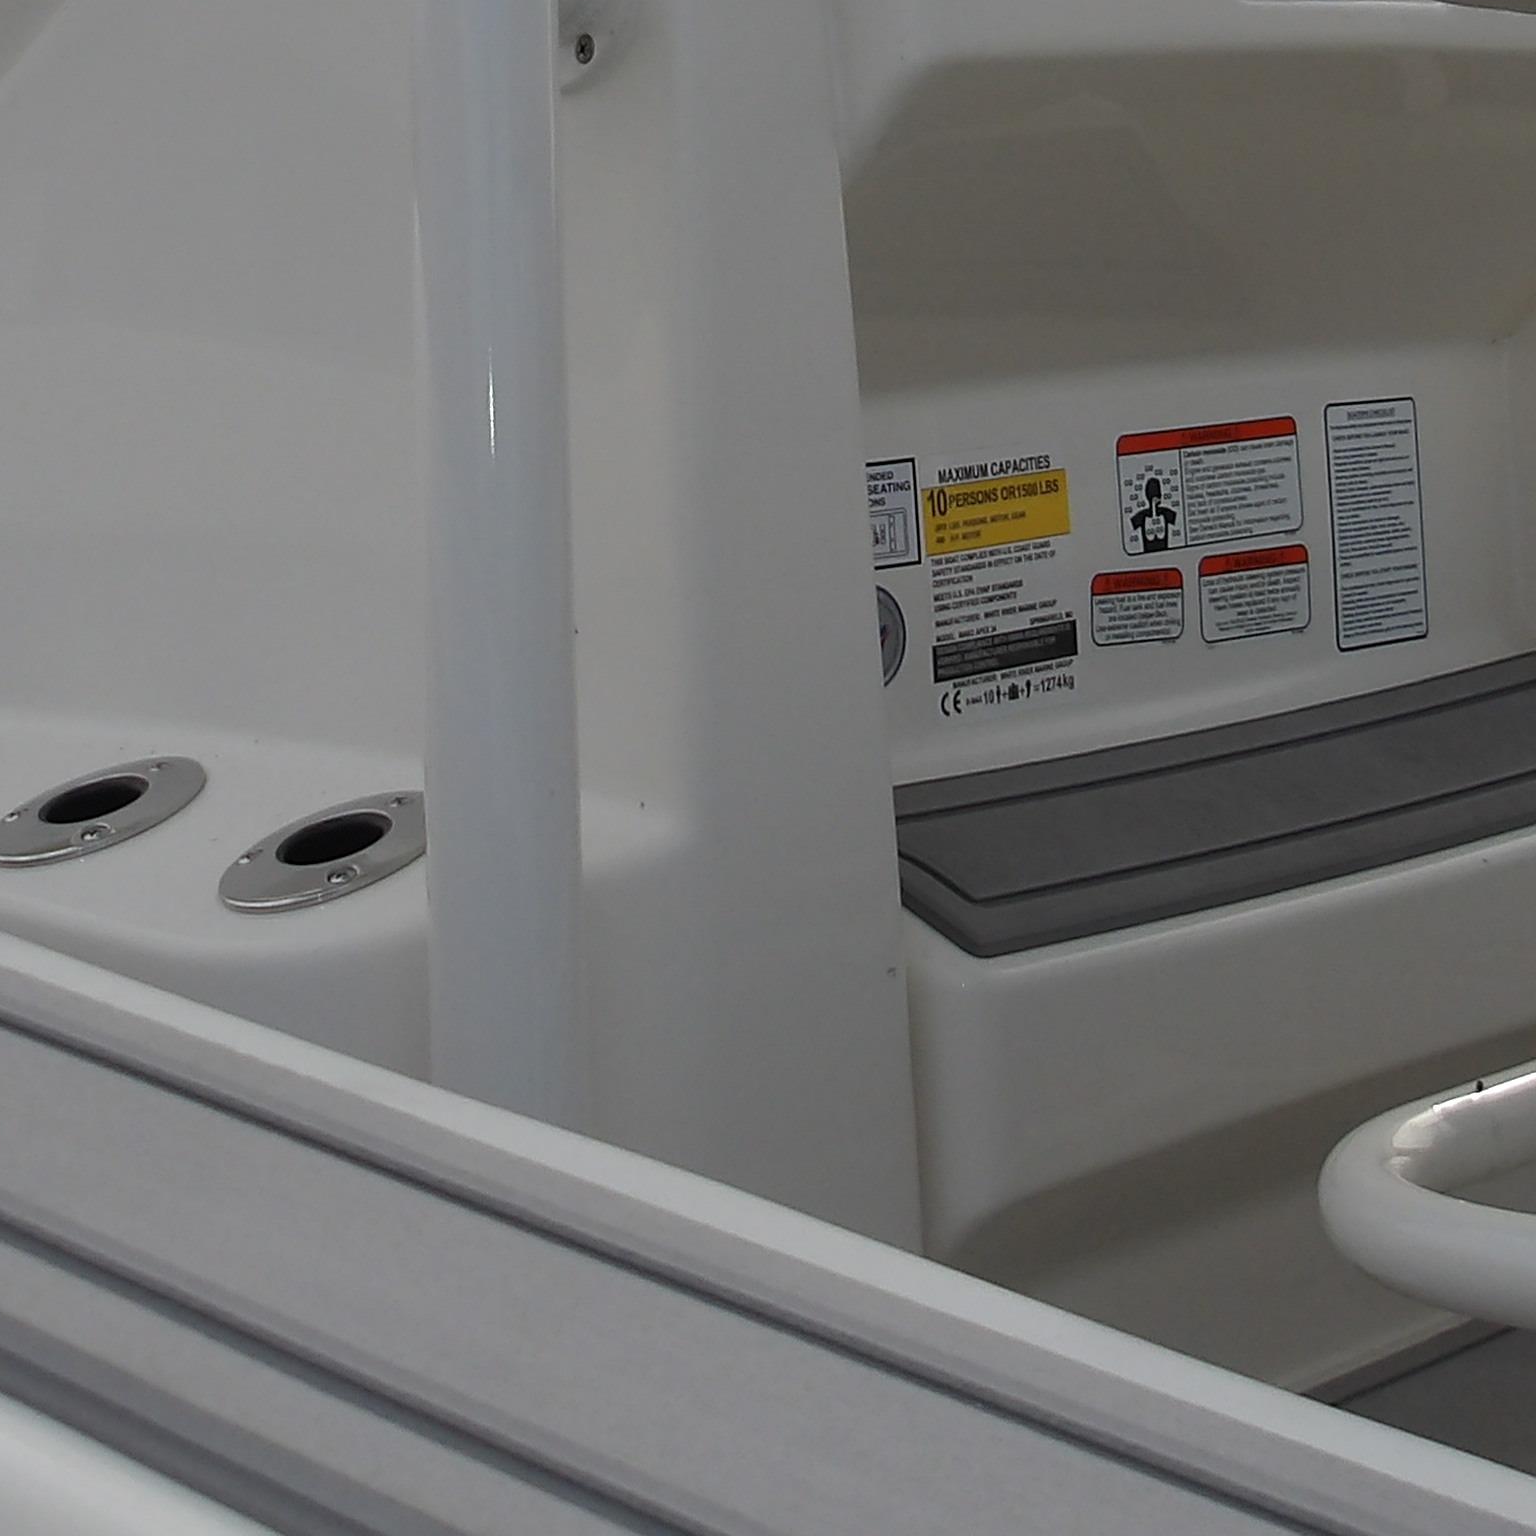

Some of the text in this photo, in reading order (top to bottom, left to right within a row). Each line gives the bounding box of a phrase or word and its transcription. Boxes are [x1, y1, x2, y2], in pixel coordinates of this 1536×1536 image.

[938, 454, 1049, 483] MAXIMUM CAPACITIES
[926, 487, 947, 517] 10
[948, 487, 998, 508] PERSONS
